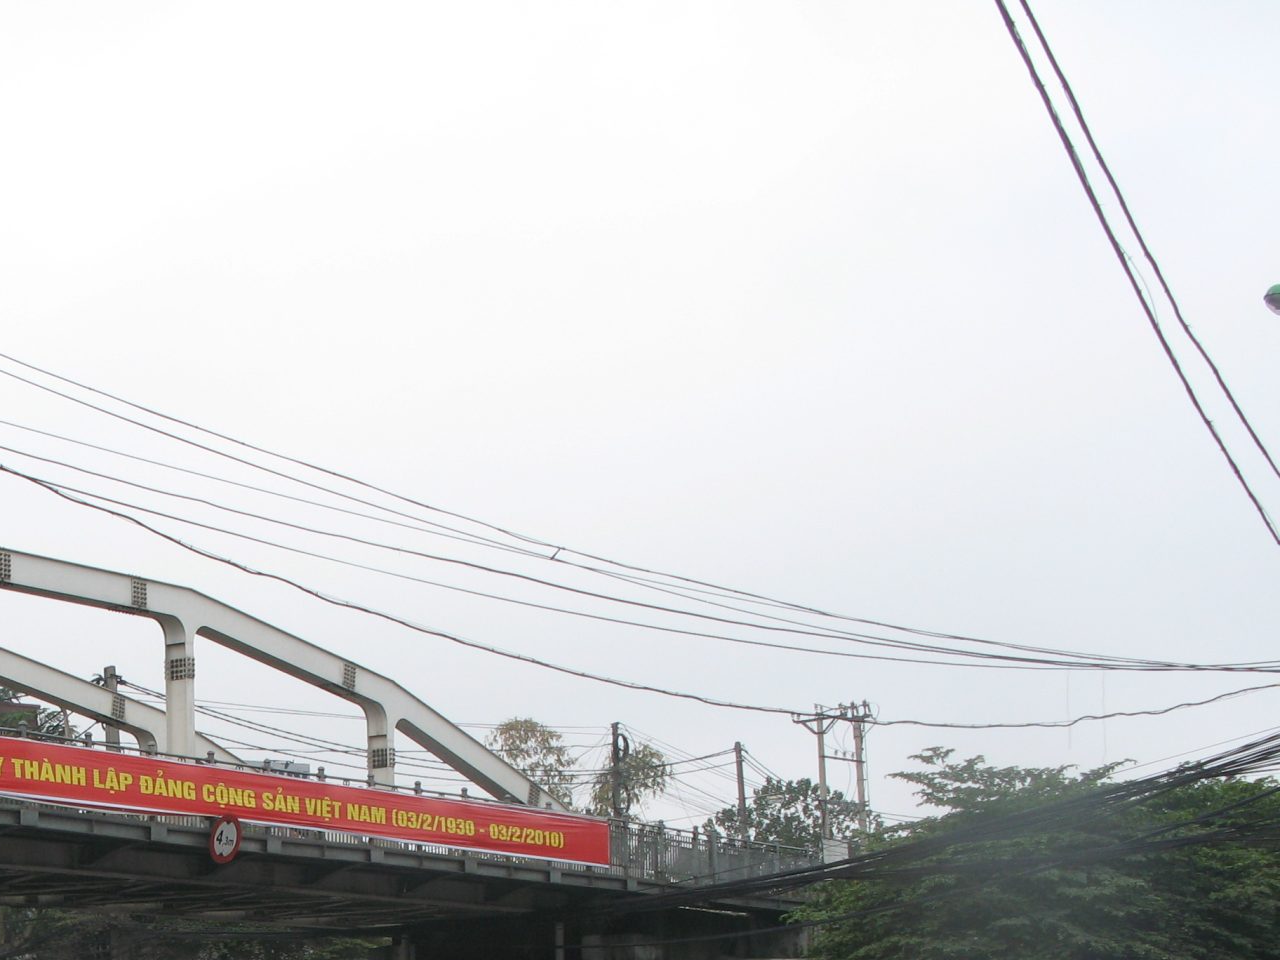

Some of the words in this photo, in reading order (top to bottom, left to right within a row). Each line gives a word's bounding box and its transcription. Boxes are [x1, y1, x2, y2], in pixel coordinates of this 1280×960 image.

[12, 758, 87, 786] THÀNH
[92, 766, 134, 793] LẬP
[139, 772, 197, 801] ĐẢNG
[201, 781, 257, 808] CỘNG
[262, 787, 301, 814] SẢN
[304, 796, 342, 822] VIỆT
[346, 803, 387, 825] NAM
[391, 808, 476, 837] (03/2/1930
[488, 823, 565, 849] 03/2/2010)
